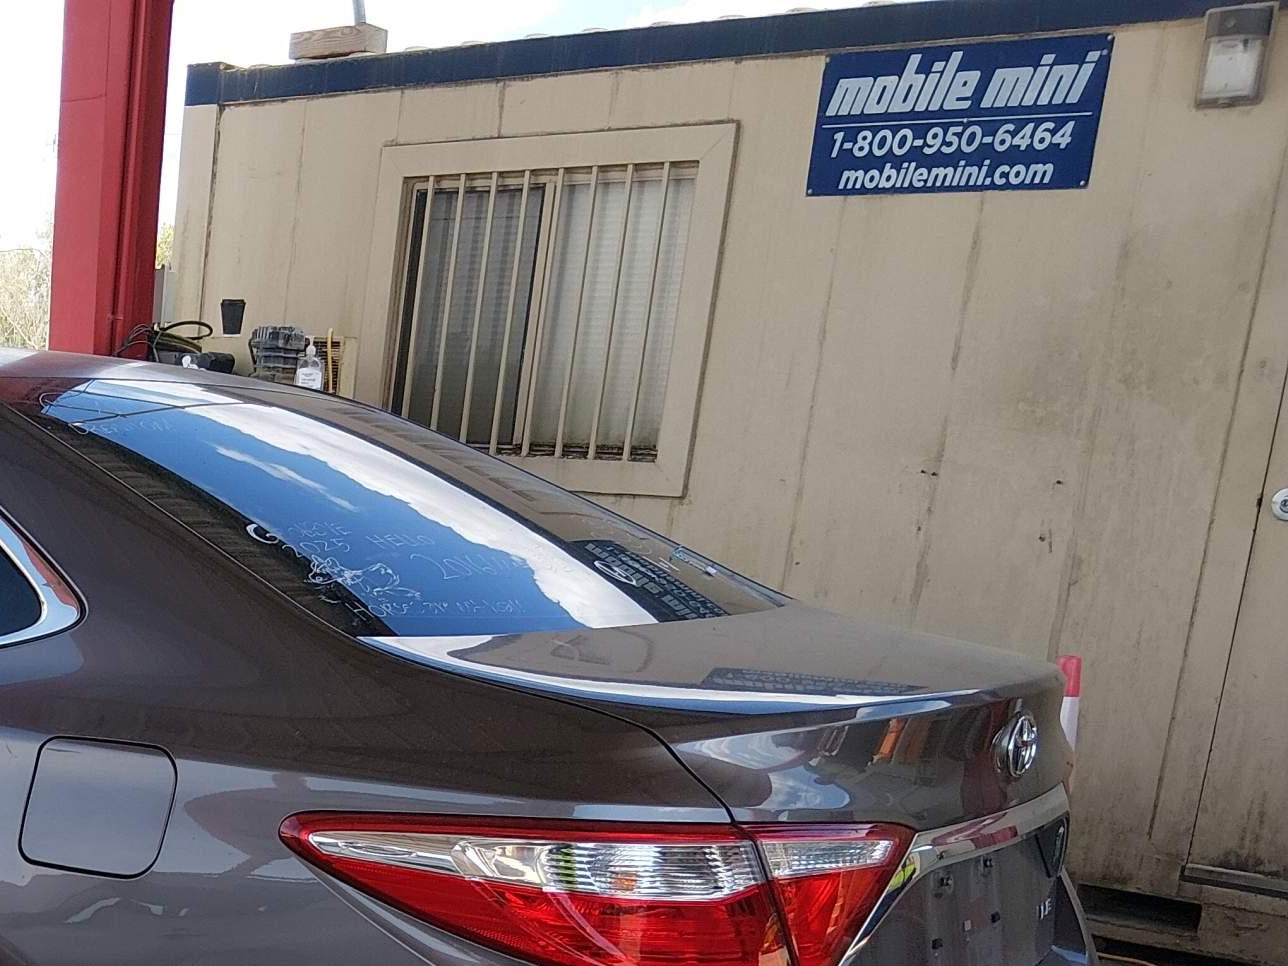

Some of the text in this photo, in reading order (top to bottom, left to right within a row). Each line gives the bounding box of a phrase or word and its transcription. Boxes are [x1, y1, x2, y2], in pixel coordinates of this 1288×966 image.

[825, 50, 1102, 116] mobile mini
[831, 120, 1075, 158] 1-800-950-6464
[838, 159, 1054, 190] mobilemini.com
